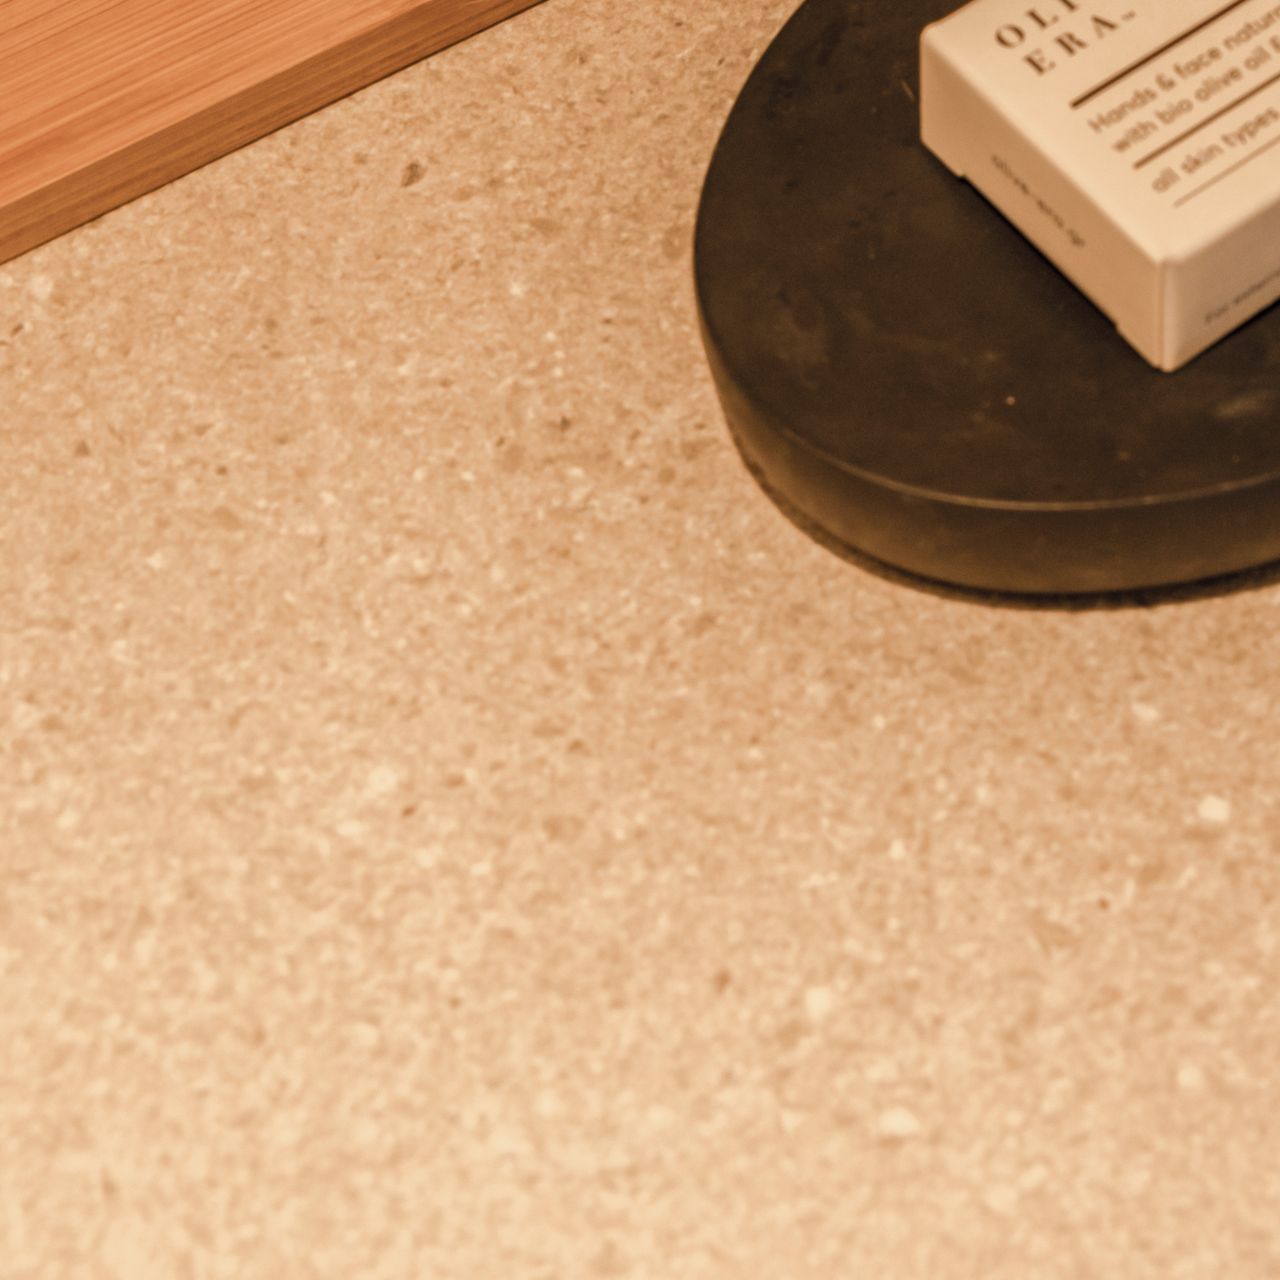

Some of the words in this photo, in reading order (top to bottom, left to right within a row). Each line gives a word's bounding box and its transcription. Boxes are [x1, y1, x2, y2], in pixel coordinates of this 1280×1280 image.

[1087, 86, 1158, 133] Hands
[1173, 46, 1223, 80] face
[1112, 120, 1158, 153] with
[1154, 98, 1194, 125] bio
[1194, 66, 1243, 103] olive
[1243, 44, 1273, 72] oil
[1151, 166, 1180, 194] all
[1180, 142, 1224, 175] skin
[1220, 106, 1280, 146] types
